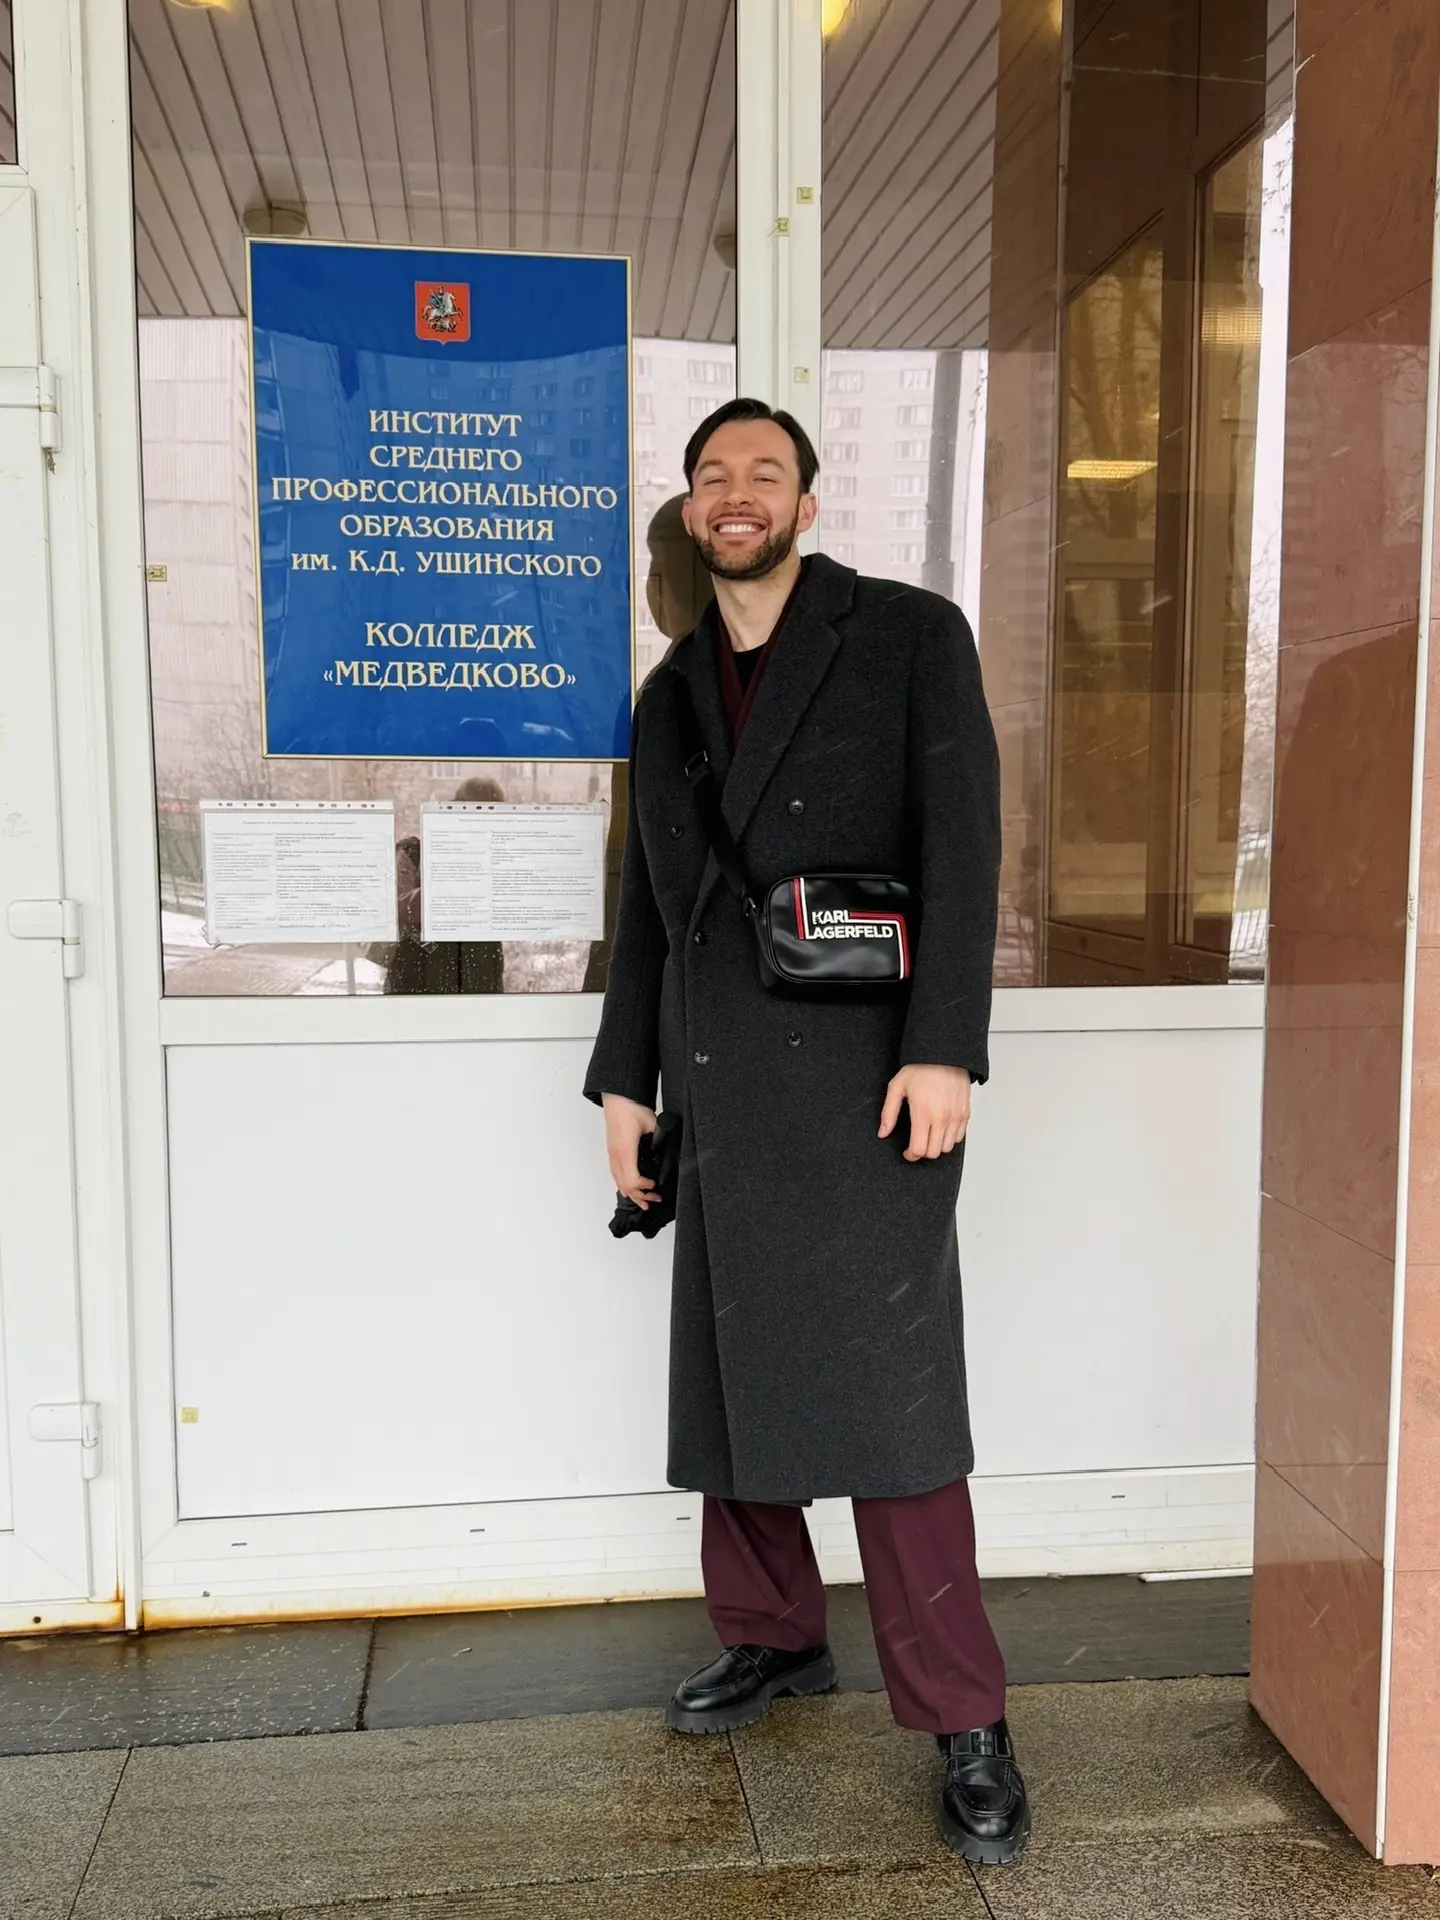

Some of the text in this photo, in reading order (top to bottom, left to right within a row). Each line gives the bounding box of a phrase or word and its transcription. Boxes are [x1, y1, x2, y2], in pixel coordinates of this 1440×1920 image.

[369, 409, 522, 437] ИНСТИТУТ
[369, 445, 522, 473] СРЕДНЕГО
[271, 477, 617, 510] ПРОФЕССИОНАЛЬНОГО
[339, 515, 555, 542] ОБРАЗОВАНИЯ
[291, 550, 602, 577] им. К.Д. УШИНСКОГО
[365, 622, 536, 653] КОЛЛЕДЖ
[324, 660, 577, 691] «МЕДВЕДКОВО»
[812, 909, 850, 924] KARL
[805, 926, 894, 940] LAGERFELD
